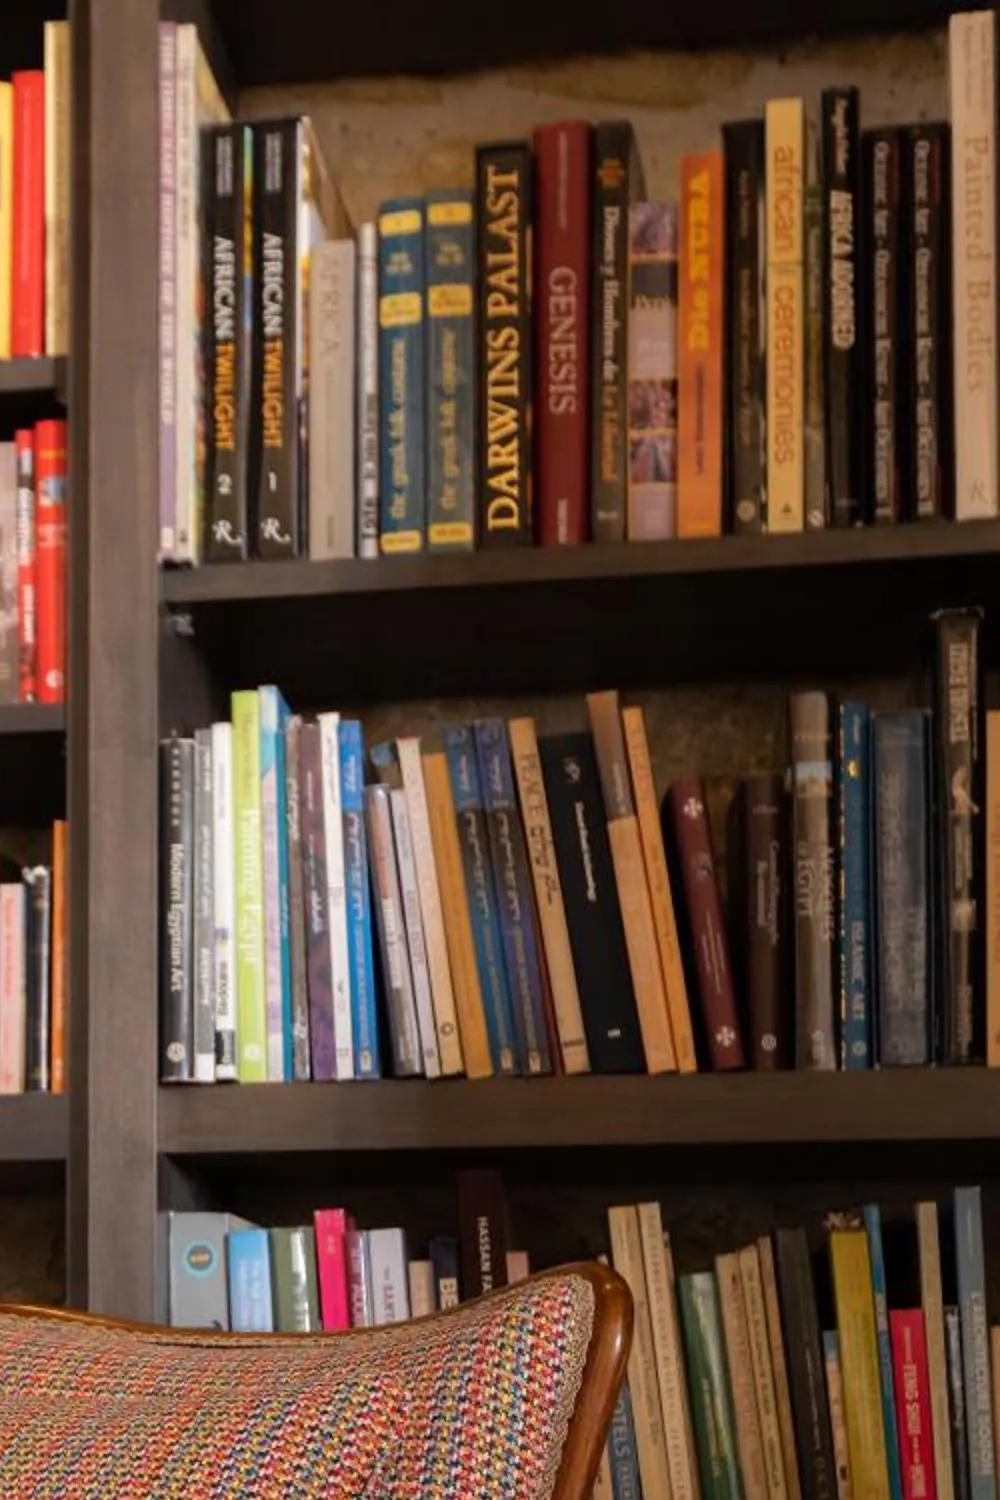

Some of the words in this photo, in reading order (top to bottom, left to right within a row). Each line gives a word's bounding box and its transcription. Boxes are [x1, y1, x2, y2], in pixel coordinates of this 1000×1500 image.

[487, 165, 520, 319] PALAST
[688, 170, 711, 283] NUBA
[773, 145, 801, 254] african
[963, 136, 991, 262] Painted
[213, 237, 237, 341] AFRICAN
[262, 233, 285, 337] AFRICAN
[319, 254, 345, 358] AFRICA
[688, 287, 711, 351] Die
[548, 267, 577, 416] GENESIS
[774, 284, 801, 465] ceremonies
[966, 280, 993, 396] Bodies
[214, 343, 237, 452] TWILIGHT
[262, 338, 284, 449] TWILIGHT
[487, 328, 520, 533] DARWINS
[519, 753, 545, 818] PEACE
[170, 843, 185, 899] Modern
[797, 860, 816, 917] EGYPT
[167, 901, 184, 963] Egyptian
[170, 966, 184, 991] Art
[239, 902, 263, 964] Egypt
[850, 920, 866, 985] ISLAMIC
[851, 992, 866, 1022] ART
[477, 1216, 492, 1271] HASSAN
[612, 1401, 631, 1457] OTELS
